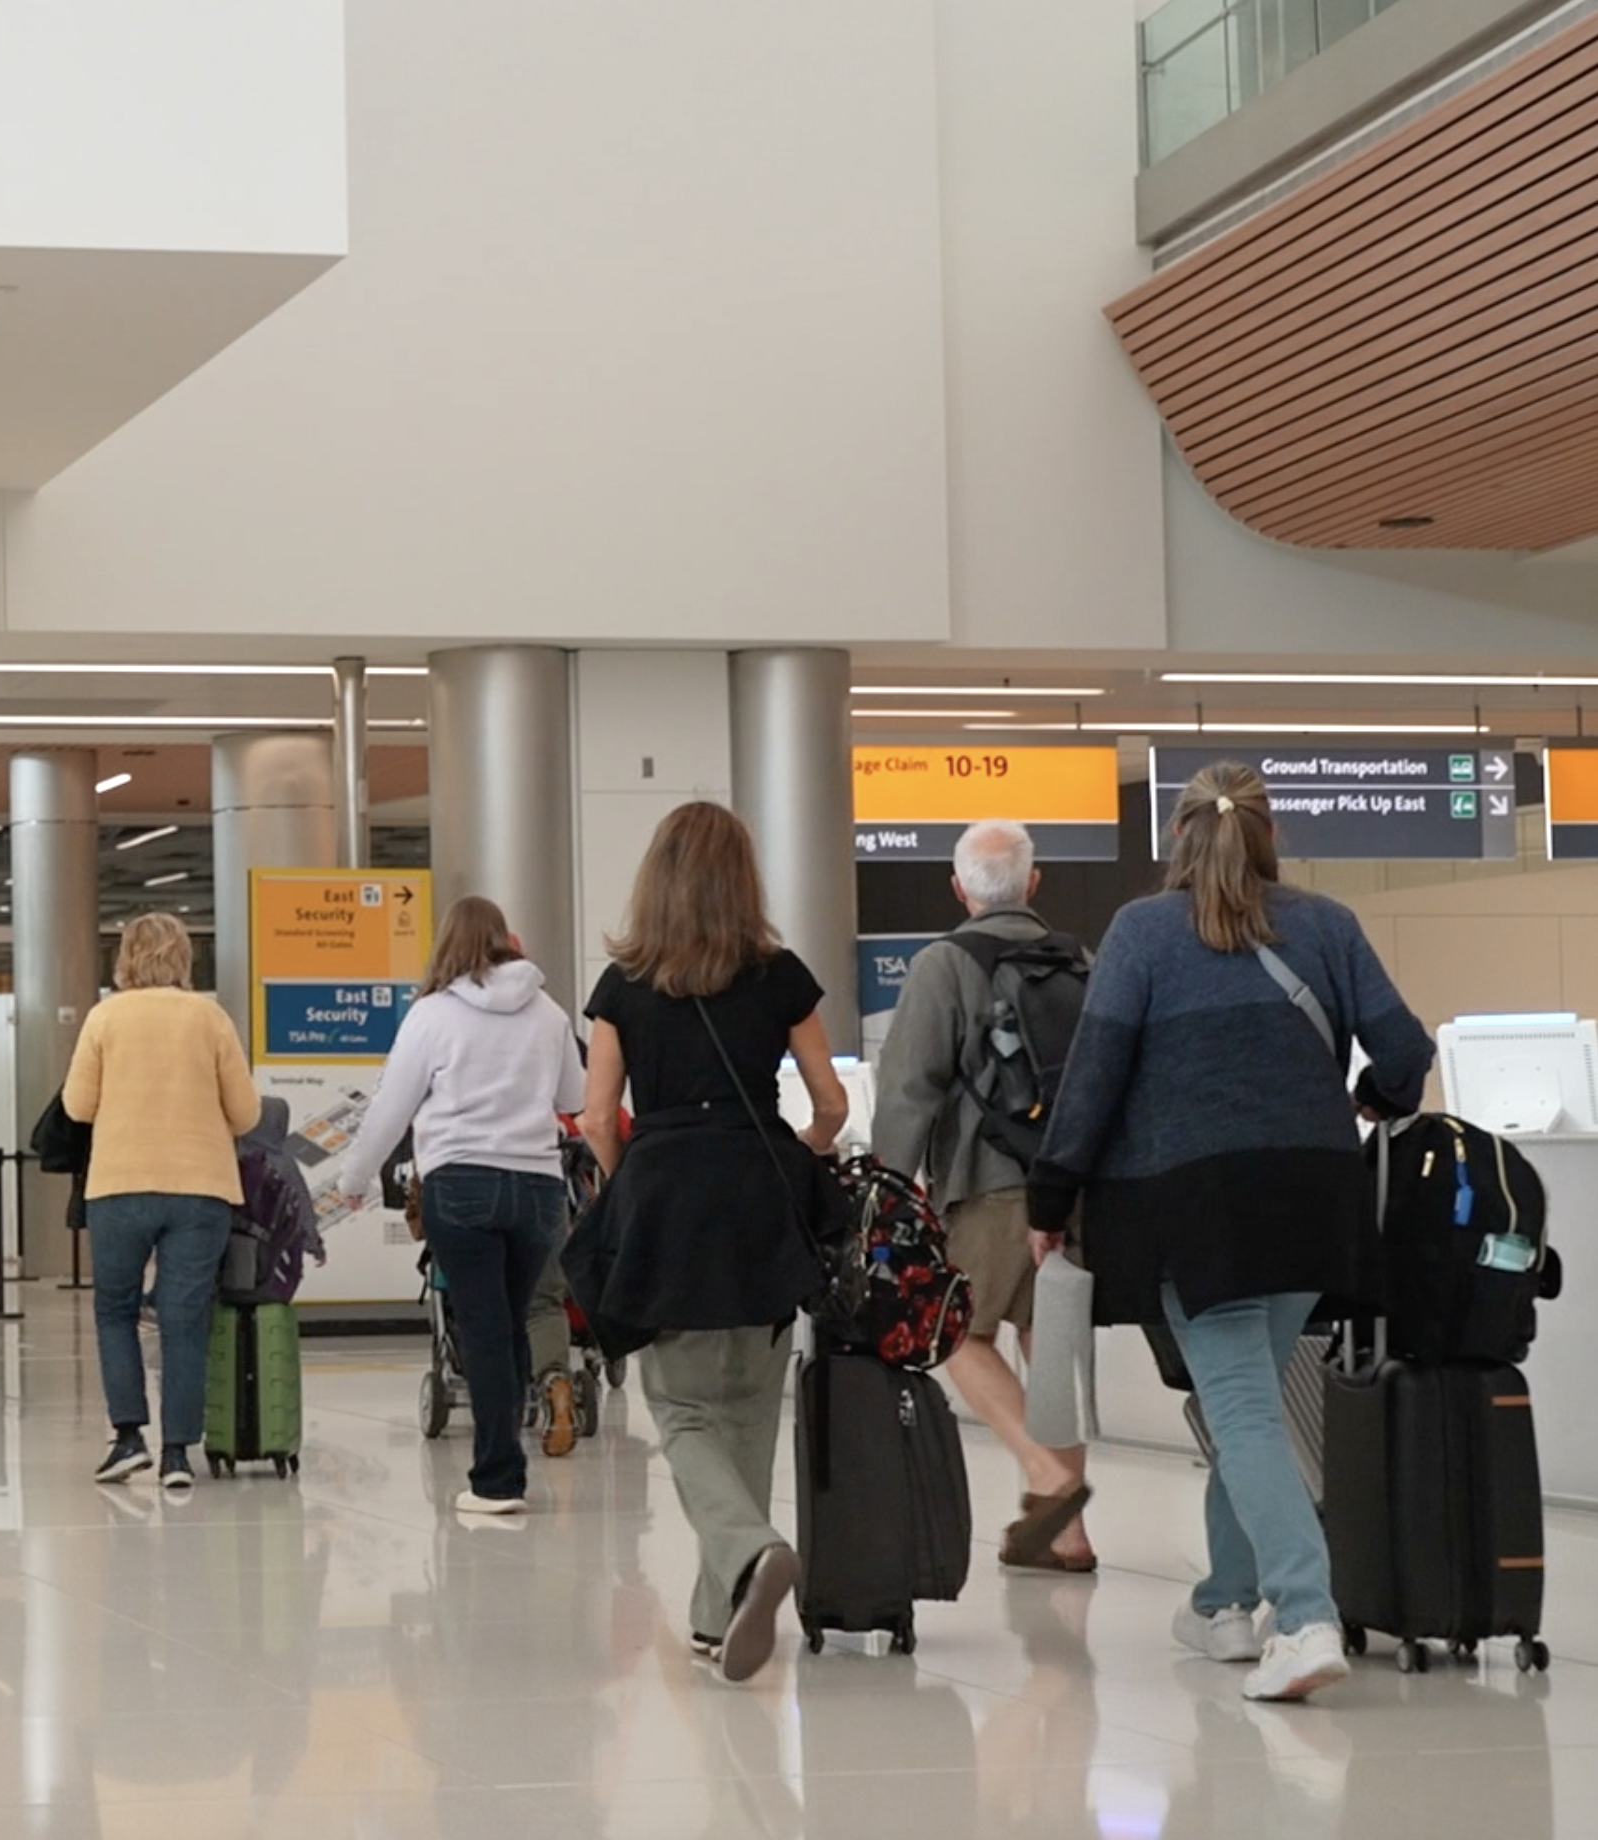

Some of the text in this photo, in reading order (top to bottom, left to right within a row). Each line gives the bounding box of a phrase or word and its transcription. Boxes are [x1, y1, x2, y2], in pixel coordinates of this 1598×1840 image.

[854, 755, 1008, 778] age Claim 10-19
[1261, 758, 1428, 779] Ground Transportation
[1269, 795, 1426, 816] assenger Pick Up East
[855, 832, 918, 852] ng West
[323, 889, 354, 902] East
[295, 907, 355, 924] Security
[316, 929, 355, 939] Screening
[873, 956, 908, 974] TSA
[335, 989, 369, 1003] East
[306, 1007, 369, 1026] Security
[288, 1031, 307, 1042] TSA
